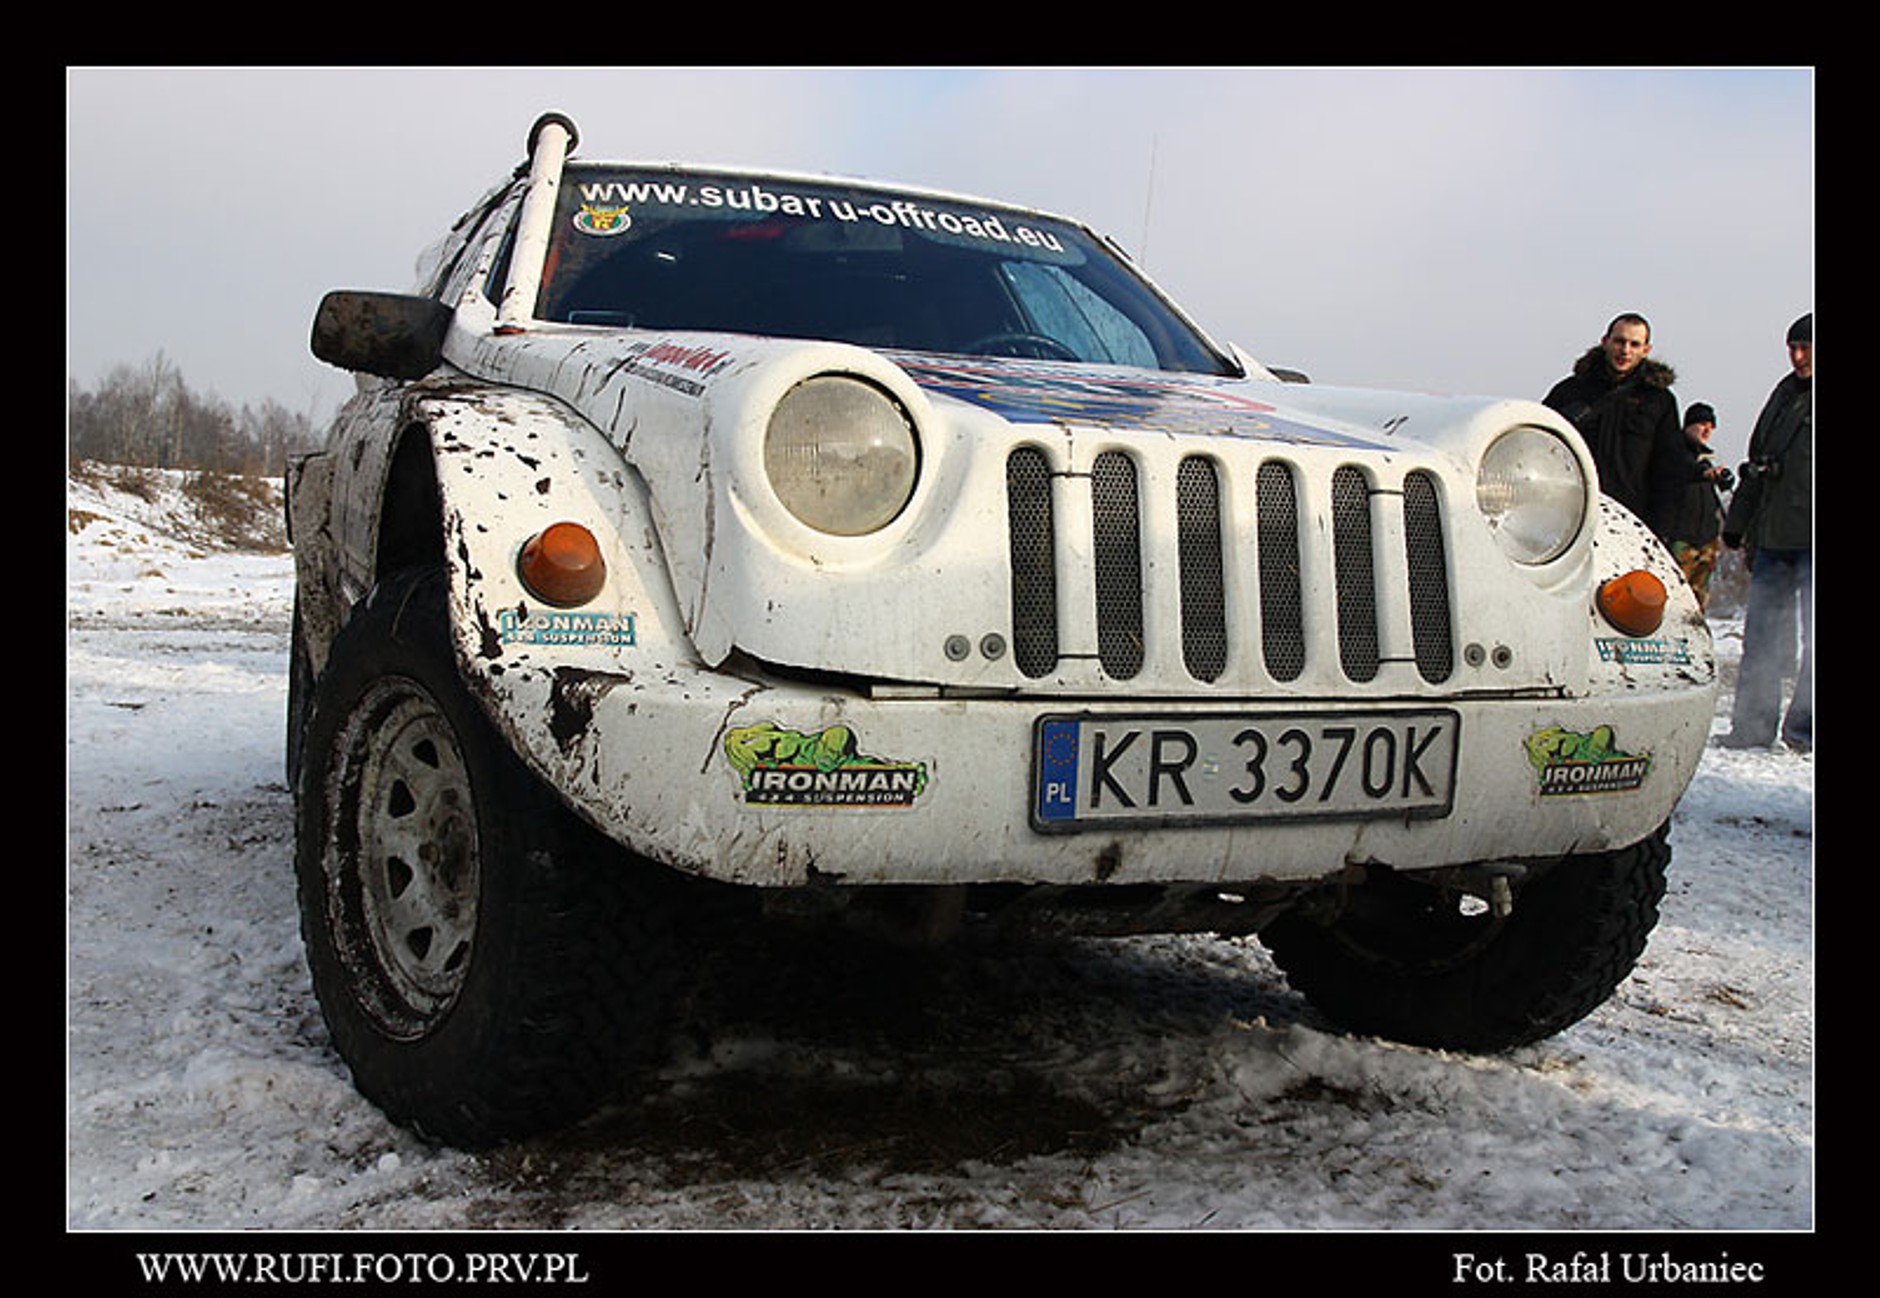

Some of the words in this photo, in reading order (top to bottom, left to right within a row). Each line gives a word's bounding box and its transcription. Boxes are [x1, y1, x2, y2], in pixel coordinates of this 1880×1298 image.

[1090, 729, 1198, 809] KR
[1228, 726, 1443, 804] 3370K
[1545, 761, 1647, 784] IRONMAN
[751, 771, 915, 792] IRONMAN
[803, 792, 906, 803] SUSPENSION
[1045, 782, 1072, 804] PL
